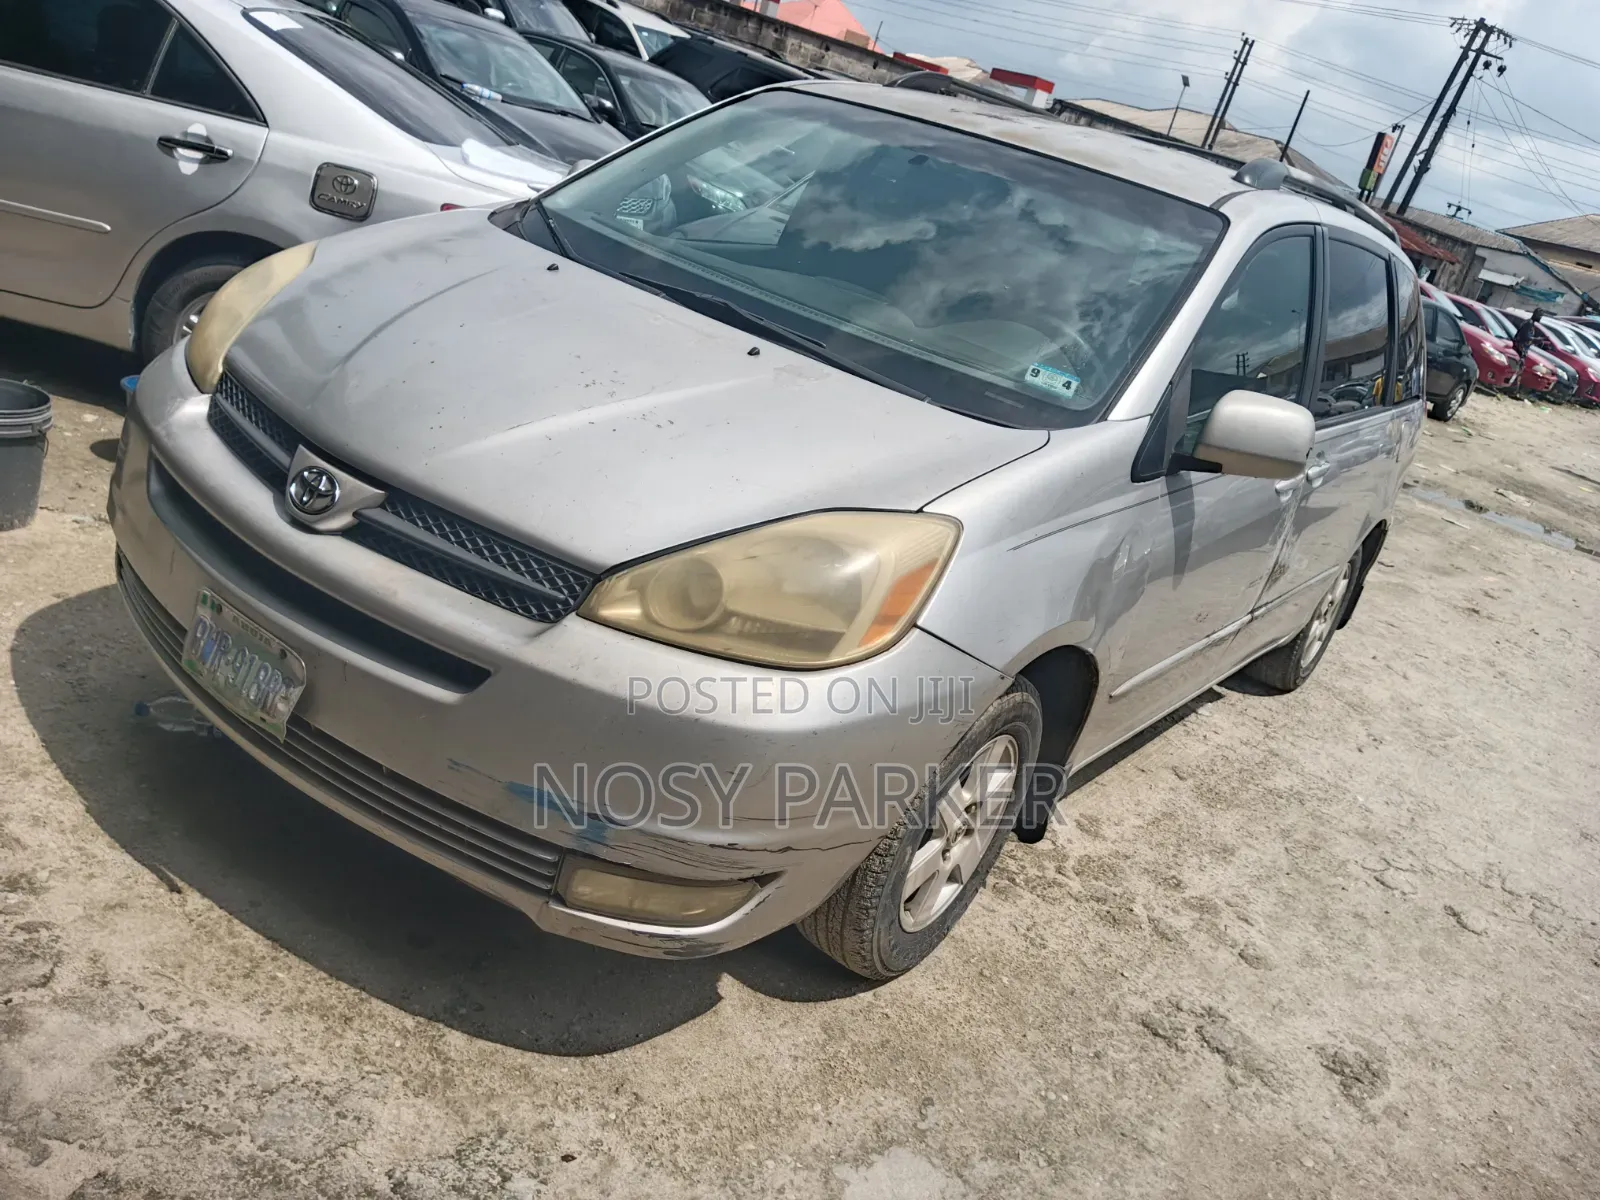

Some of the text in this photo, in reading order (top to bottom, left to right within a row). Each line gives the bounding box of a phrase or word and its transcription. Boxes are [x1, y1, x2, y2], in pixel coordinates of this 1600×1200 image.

[317, 193, 367, 209] CAMRY
[1030, 368, 1041, 378] 9
[1062, 380, 1072, 390] 4
